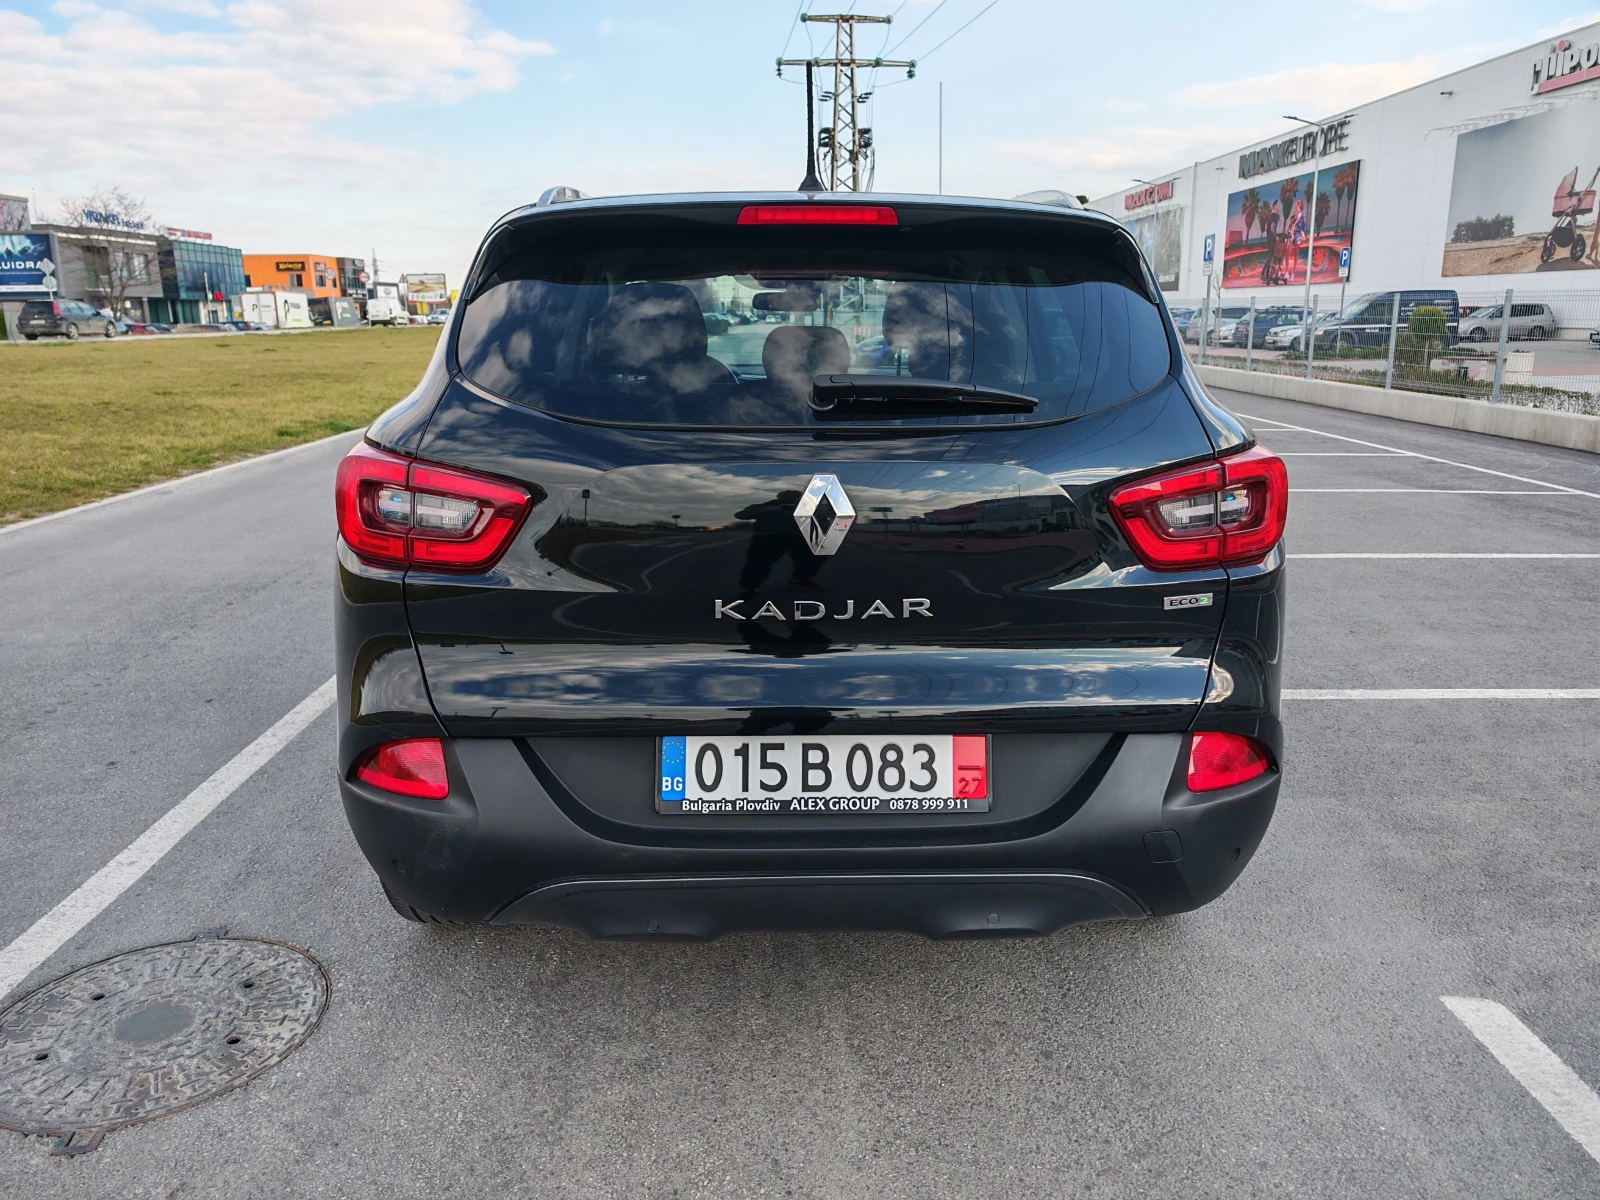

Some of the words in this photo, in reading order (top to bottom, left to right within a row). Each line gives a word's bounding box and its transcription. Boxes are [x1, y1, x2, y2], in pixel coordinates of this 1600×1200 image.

[1124, 181, 1173, 211] MAXCOM
[1170, 596, 1209, 606] ECO2
[715, 598, 934, 620] KADJAR
[662, 777, 683, 791] BG
[958, 777, 981, 793] 27
[682, 799, 732, 813] Bulgaria
[736, 799, 780, 811] Plovdiv
[790, 798, 825, 810] ALEX
[829, 798, 880, 810] GROUP
[890, 799, 919, 810] 0878
[922, 799, 944, 810] 999
[947, 798, 968, 809] 911
